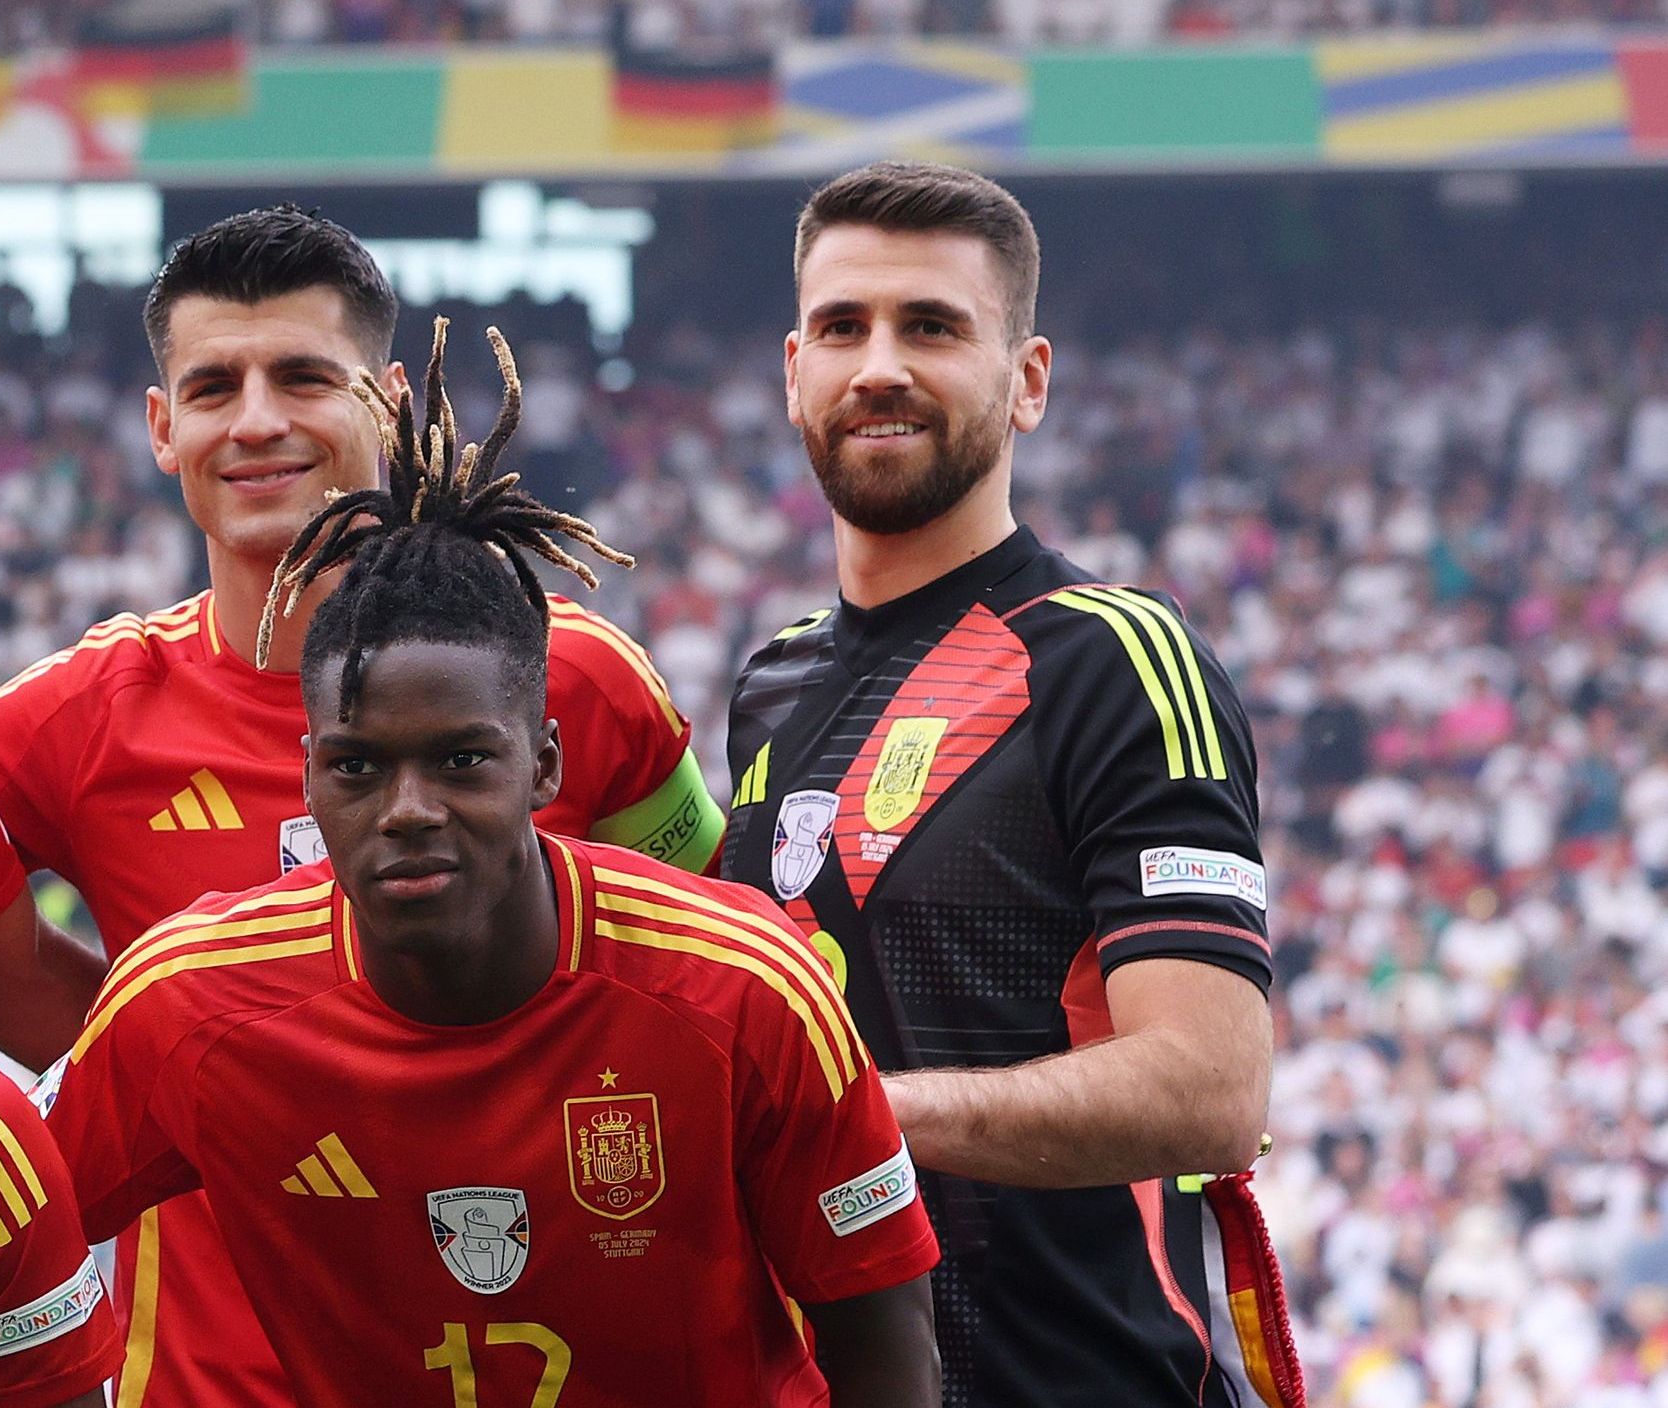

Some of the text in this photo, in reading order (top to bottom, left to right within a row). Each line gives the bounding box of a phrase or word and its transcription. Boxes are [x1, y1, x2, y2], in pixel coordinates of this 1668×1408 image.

[646, 795, 700, 859] SPECT
[1145, 851, 1176, 863] UEFA
[1146, 862, 1263, 893] FOUNDATION
[431, 1190, 520, 1202] UEFA NATIONS LEAGUE
[823, 1186, 854, 1206] UEFA
[827, 1167, 908, 1222] FOUNDA
[463, 1276, 494, 1290] WINNER
